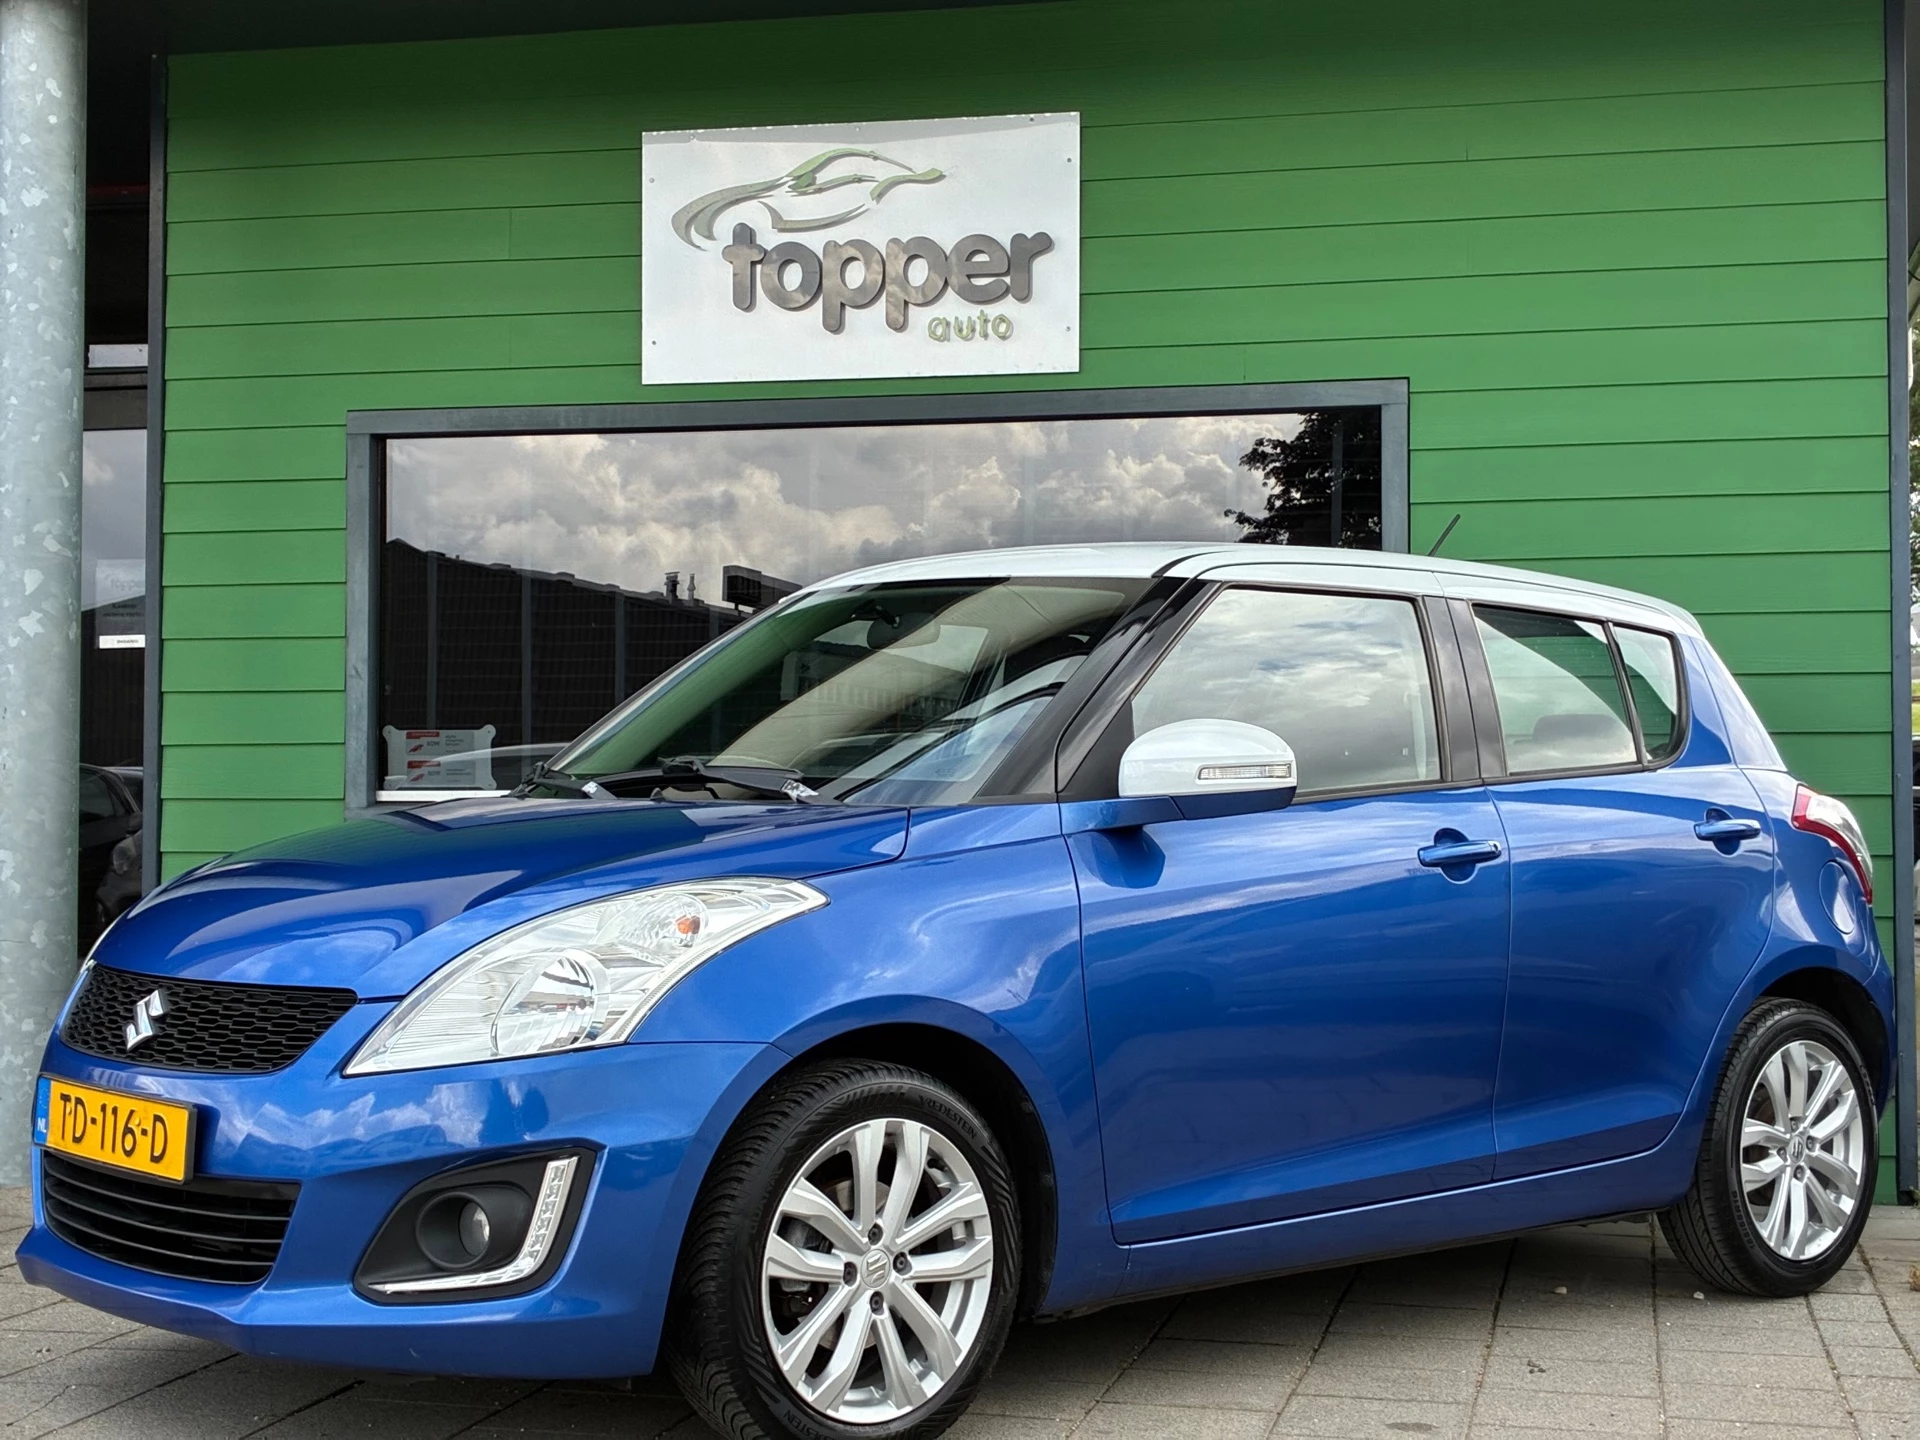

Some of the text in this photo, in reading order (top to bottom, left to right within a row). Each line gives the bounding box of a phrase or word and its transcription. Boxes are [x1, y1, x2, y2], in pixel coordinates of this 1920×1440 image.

[722, 222, 1053, 331] topper
[928, 309, 1012, 341] auto
[60, 1092, 168, 1164] TD-116-D
